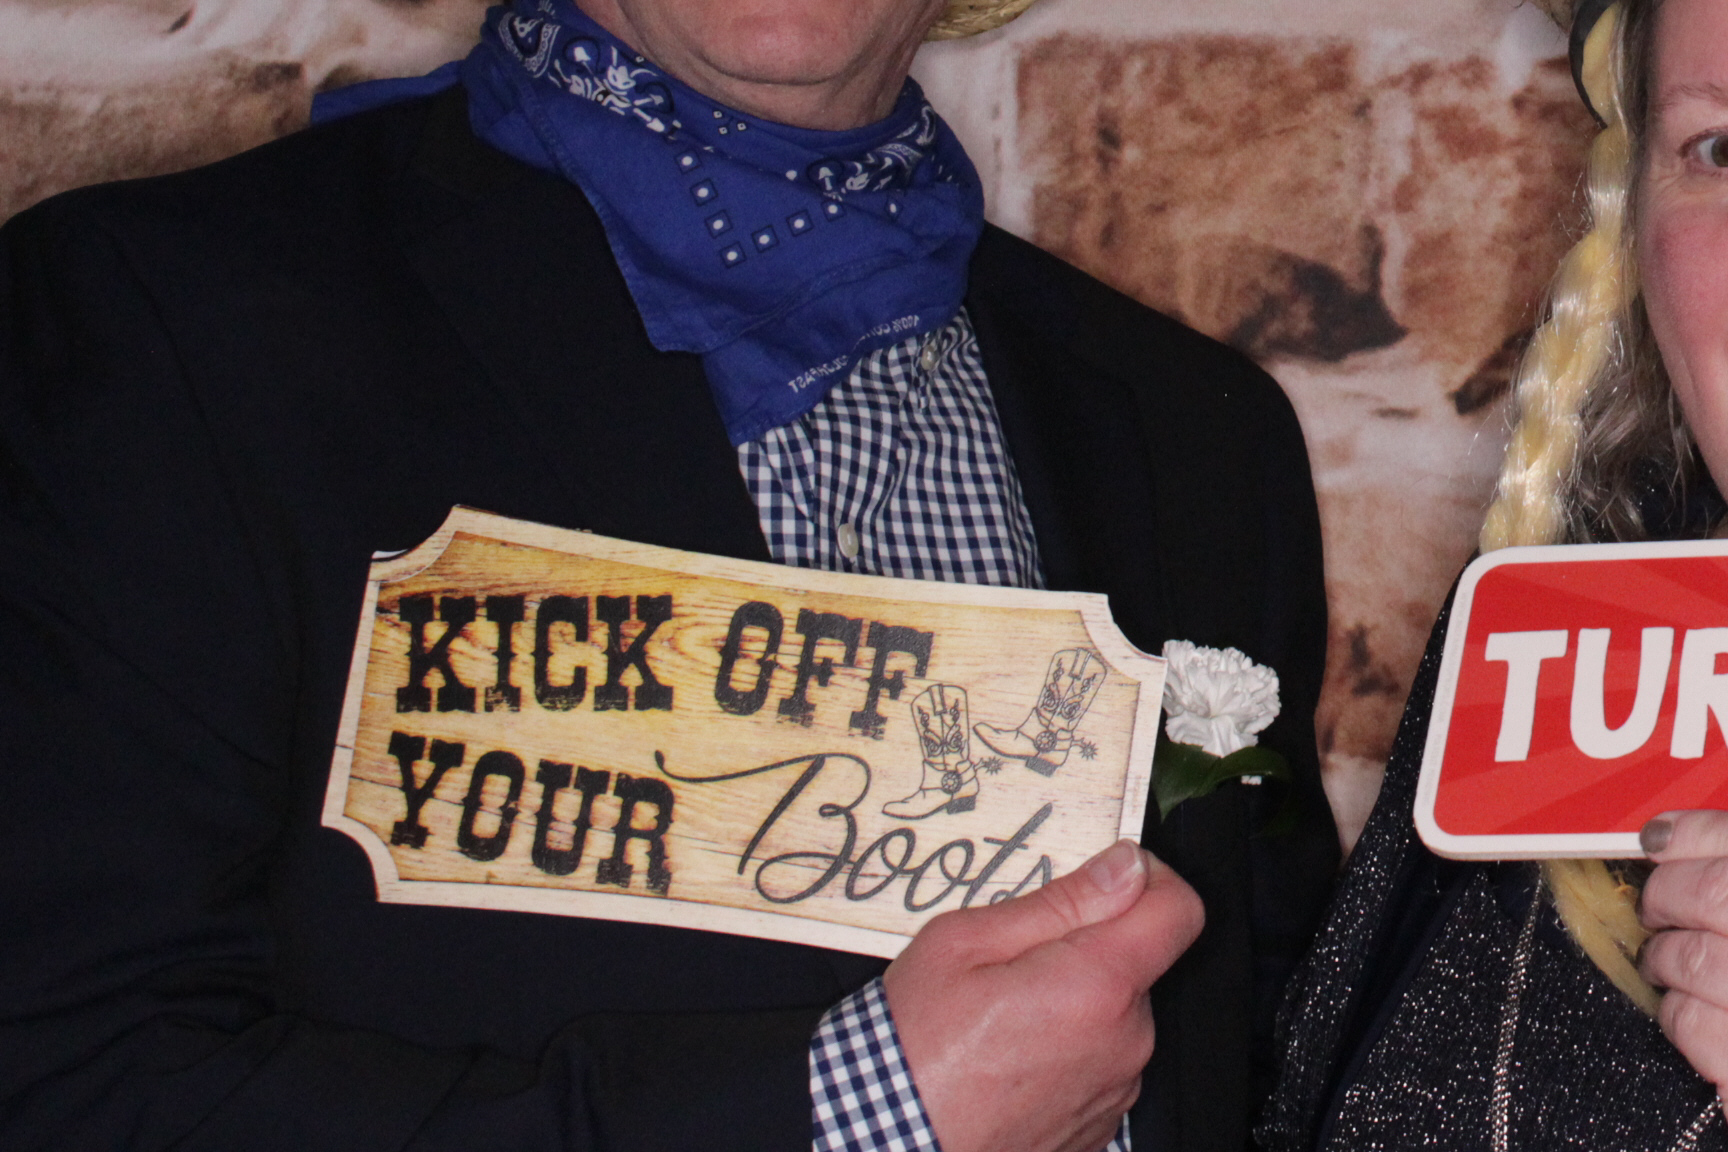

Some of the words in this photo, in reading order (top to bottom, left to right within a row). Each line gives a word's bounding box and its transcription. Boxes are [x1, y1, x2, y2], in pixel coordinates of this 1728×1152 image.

[396, 594, 673, 713] KICK
[715, 600, 934, 740] OFF
[388, 731, 674, 895] YOUR
